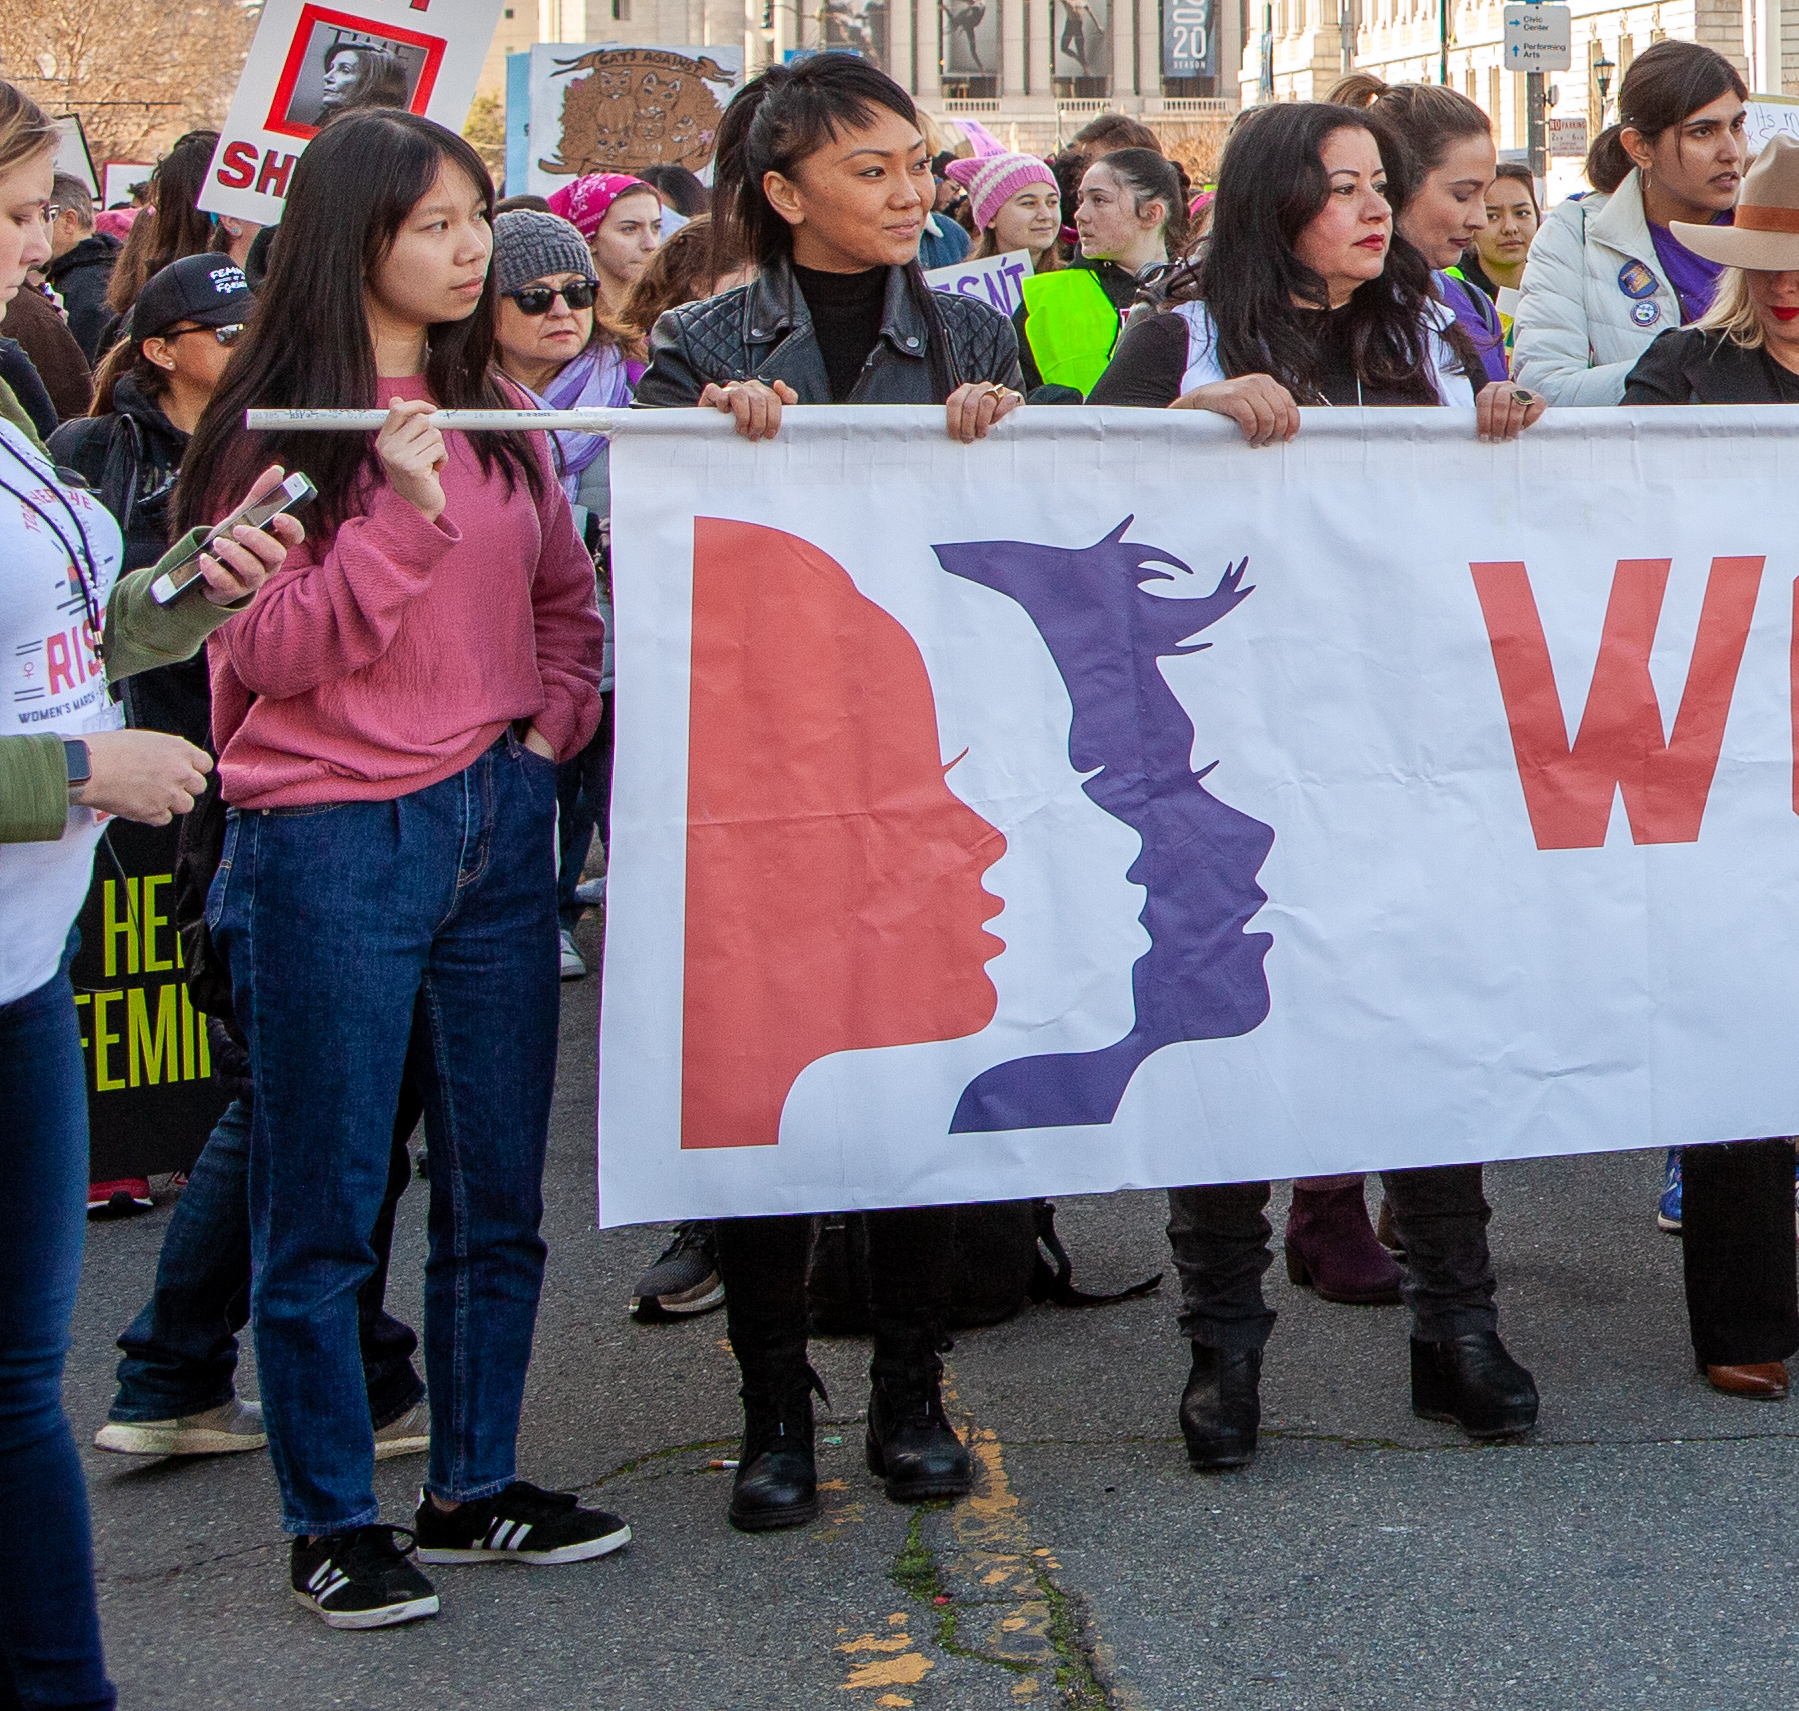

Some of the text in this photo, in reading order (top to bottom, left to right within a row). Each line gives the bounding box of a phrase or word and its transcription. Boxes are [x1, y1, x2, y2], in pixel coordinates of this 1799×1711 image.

[1523, 43, 1566, 52] Performing
[599, 51, 702, 75] CATS AGAINST
[1173, 61, 1206, 69] SEASON
[1561, 119, 1586, 129] PARKING
[46, 607, 106, 695] RIS
[18, 692, 97, 724] WOMEN'S MARCH
[104, 873, 185, 977] HE
